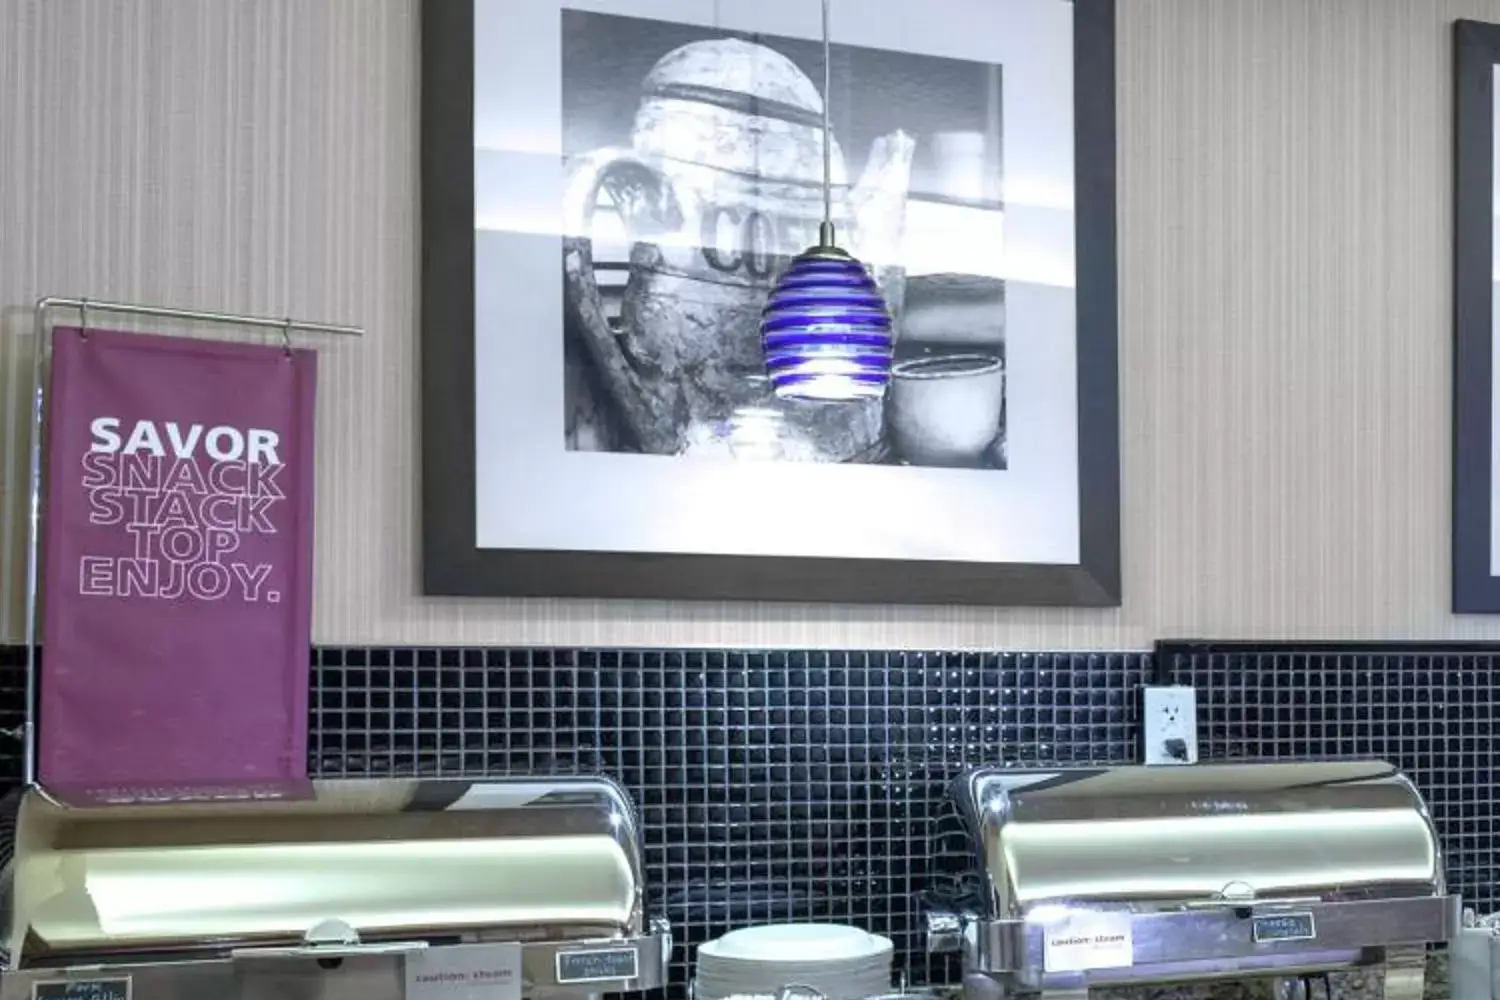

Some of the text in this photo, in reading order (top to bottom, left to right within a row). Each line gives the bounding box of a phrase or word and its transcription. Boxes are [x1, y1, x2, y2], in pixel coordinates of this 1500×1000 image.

[89, 417, 280, 465] SAVOR
[81, 451, 286, 499] SNACK
[89, 486, 278, 533] STACK
[125, 522, 240, 564] TOP
[79, 556, 281, 602] ENJOY.
